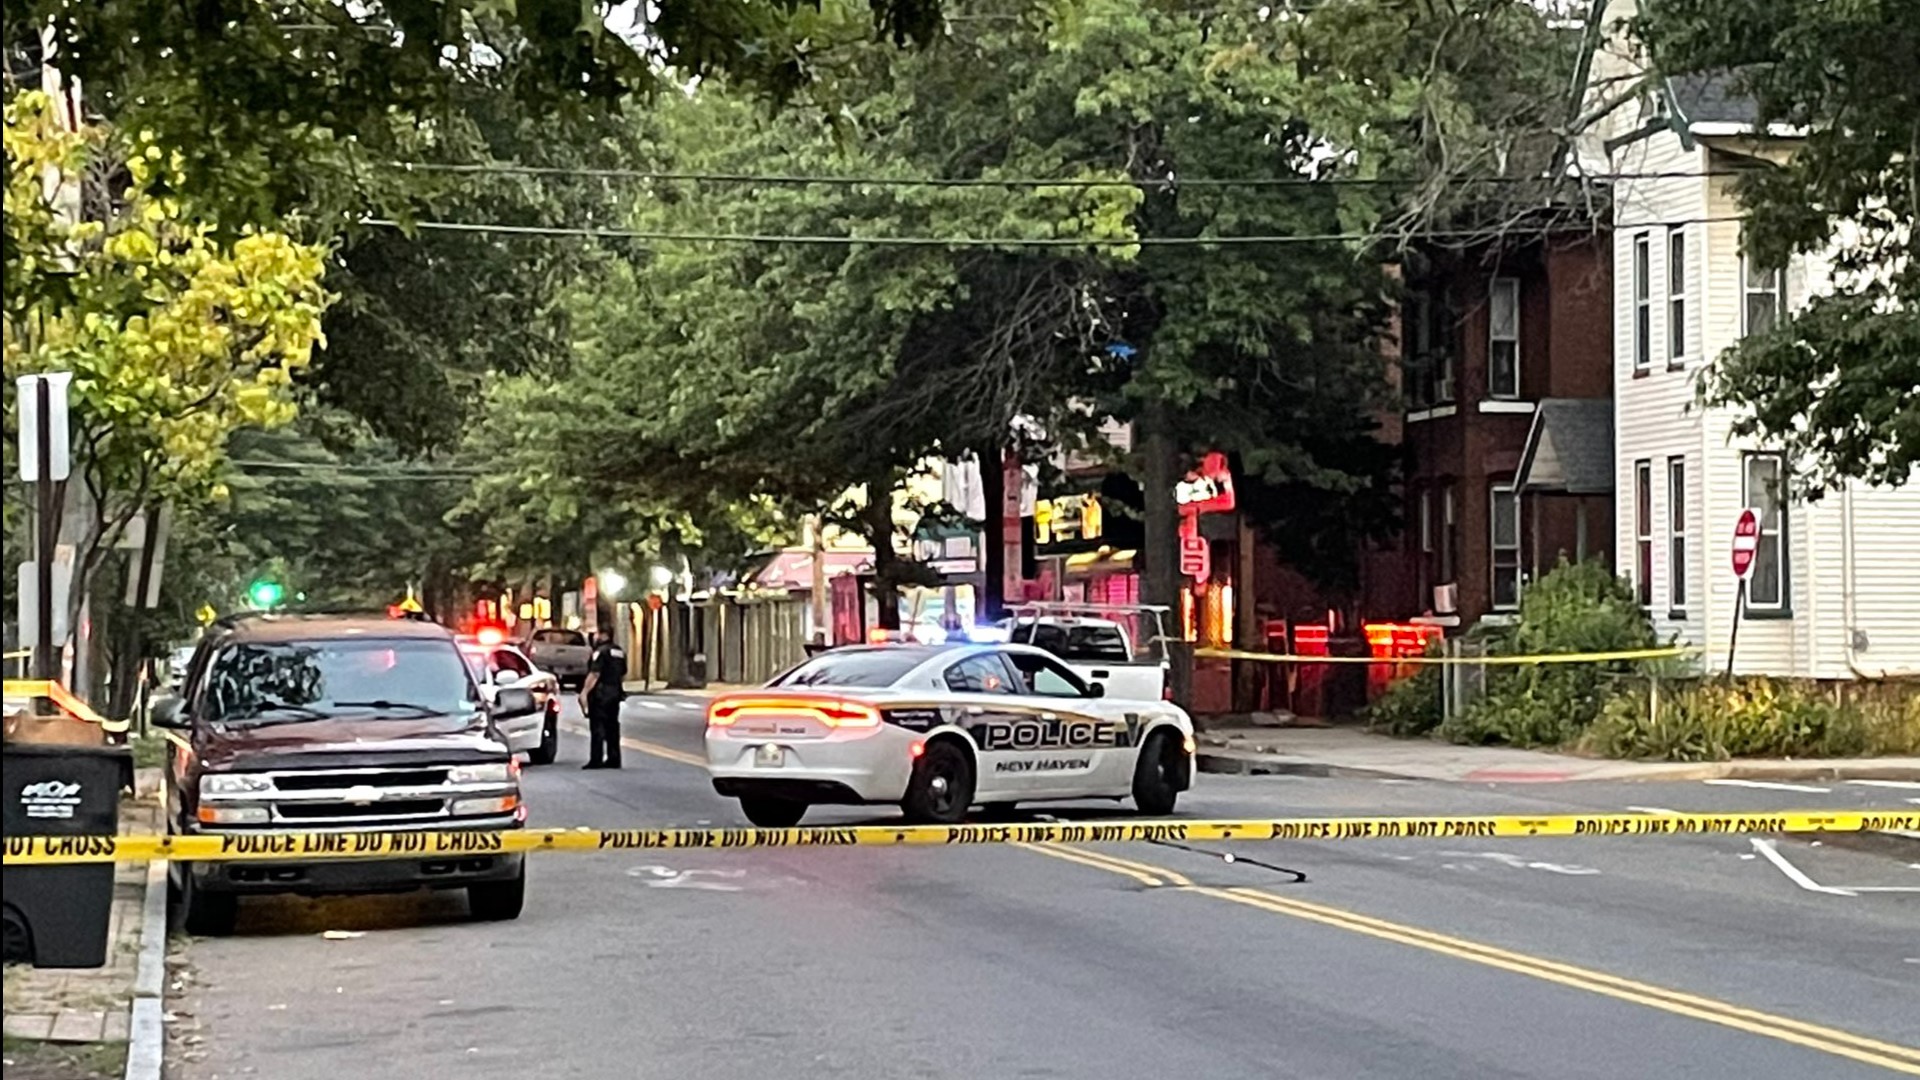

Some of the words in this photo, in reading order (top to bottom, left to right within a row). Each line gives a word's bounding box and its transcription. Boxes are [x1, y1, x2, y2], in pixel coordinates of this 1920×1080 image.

[985, 720, 1116, 750] POLICE
[996, 760, 1034, 773] NEW
[1036, 758, 1090, 771] HAVEN
[946, 827, 1011, 843] POLICE
[1016, 826, 1055, 842] LINE
[1061, 826, 1086, 842] DO
[1091, 825, 1126, 841] NOT
[1130, 824, 1188, 841] CROSS
[1271, 823, 1331, 839] POLICE
[1336, 822, 1372, 838] LINE
[1378, 821, 1400, 837] DO
[1406, 821, 1438, 837] NOT
[1441, 820, 1497, 836] CROSS
[1575, 820, 1631, 836] POLICE
[1635, 819, 1671, 835] LINE
[1673, 818, 1696, 834] DO
[1701, 819, 1732, 833] NOT
[1735, 818, 1787, 834] CROSS
[1862, 817, 1914, 831] POLICE
[45, 835, 115, 855] CROSS
[221, 834, 296, 853] POLICE
[302, 832, 348, 852] LINE
[354, 832, 382, 851] DO
[388, 831, 426, 851] NOT
[436, 830, 502, 851] CROSS
[598, 831, 668, 848] POLICE
[674, 830, 716, 847] LINE
[721, 830, 748, 847] DO
[754, 829, 788, 847] NOT
[796, 828, 857, 846] CROSS
